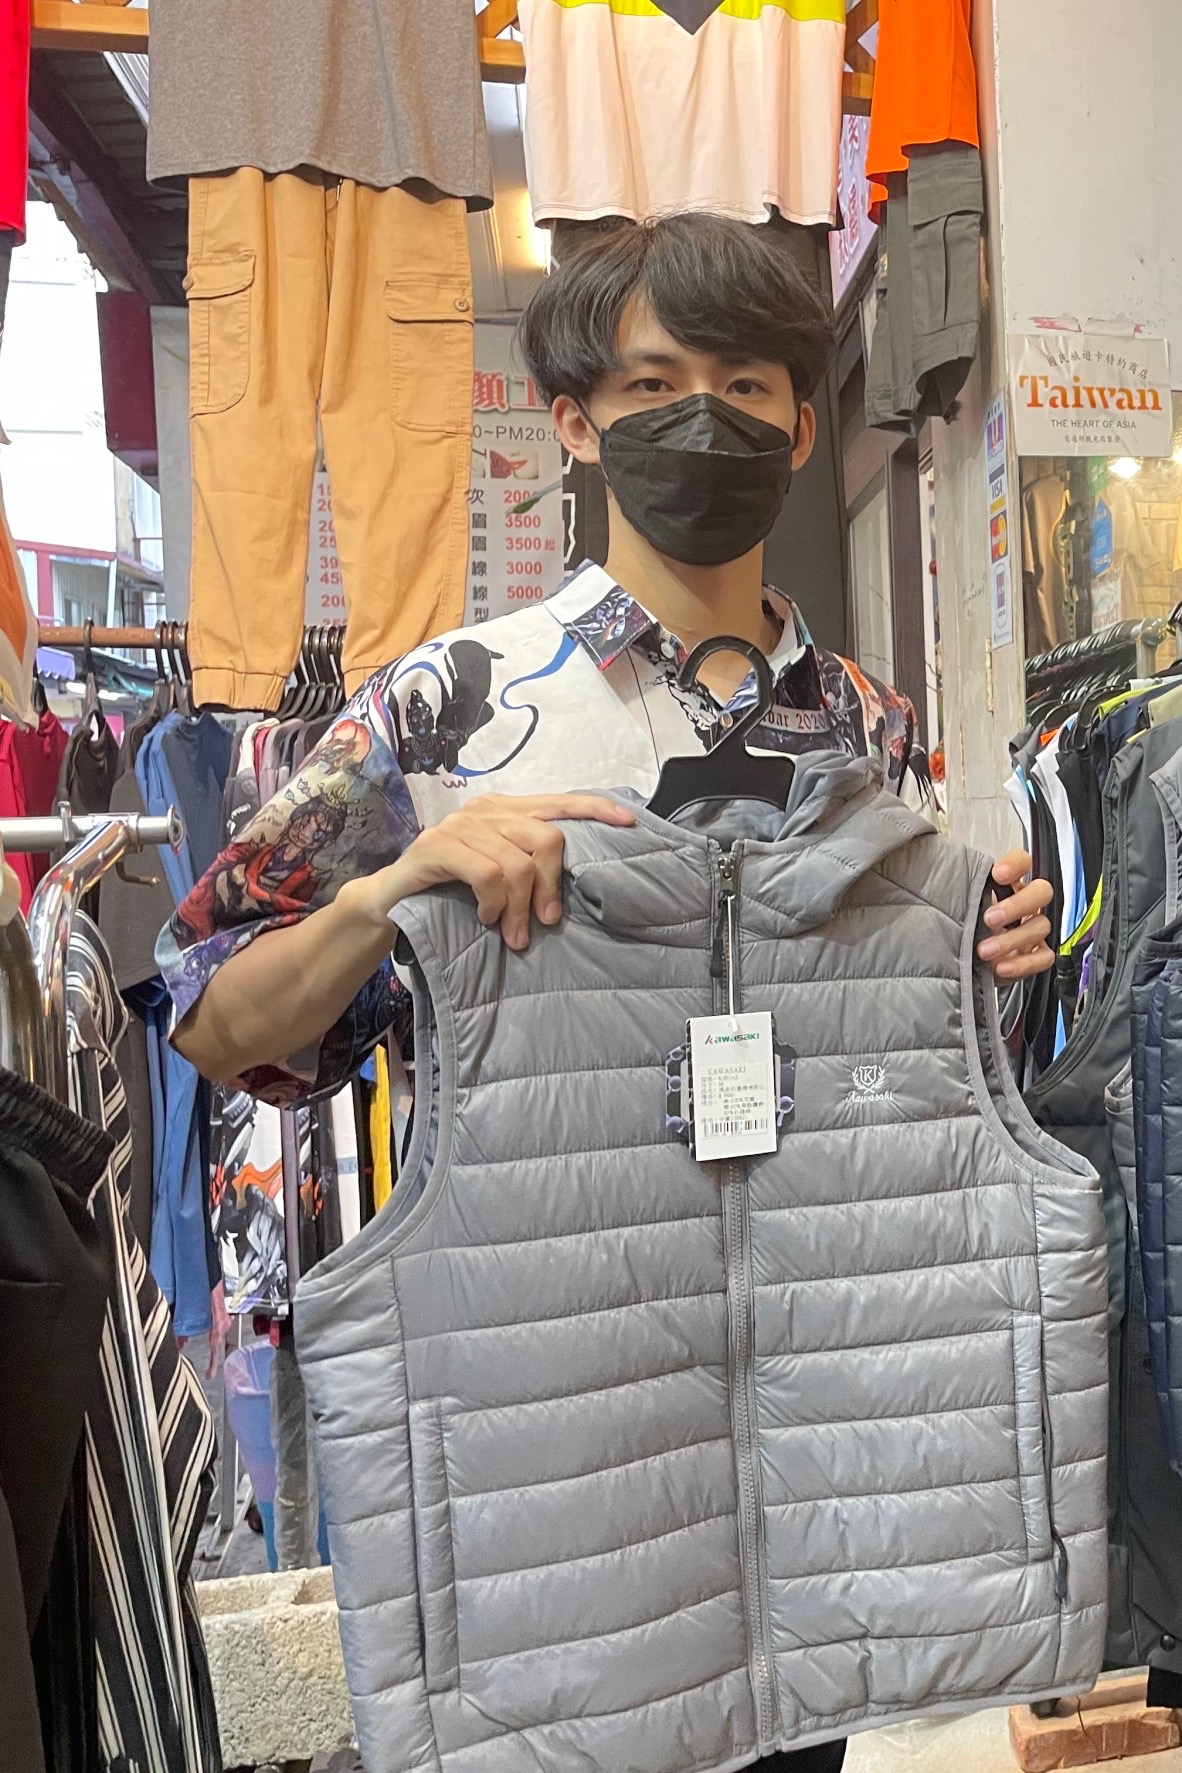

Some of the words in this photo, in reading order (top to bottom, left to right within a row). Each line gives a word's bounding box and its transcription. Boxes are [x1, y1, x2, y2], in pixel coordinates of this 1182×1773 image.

[1018, 375, 1162, 411] Taiwan
[1051, 419, 1068, 428] THE
[1071, 420, 1099, 428] HEART
[1102, 420, 1114, 428] OF
[1117, 420, 1137, 429] ASIA
[505, 515, 541, 528] 3500
[506, 538, 541, 550] 3500
[507, 562, 542, 575] 3000
[507, 586, 543, 599] 5000
[796, 712, 826, 730] 2020
